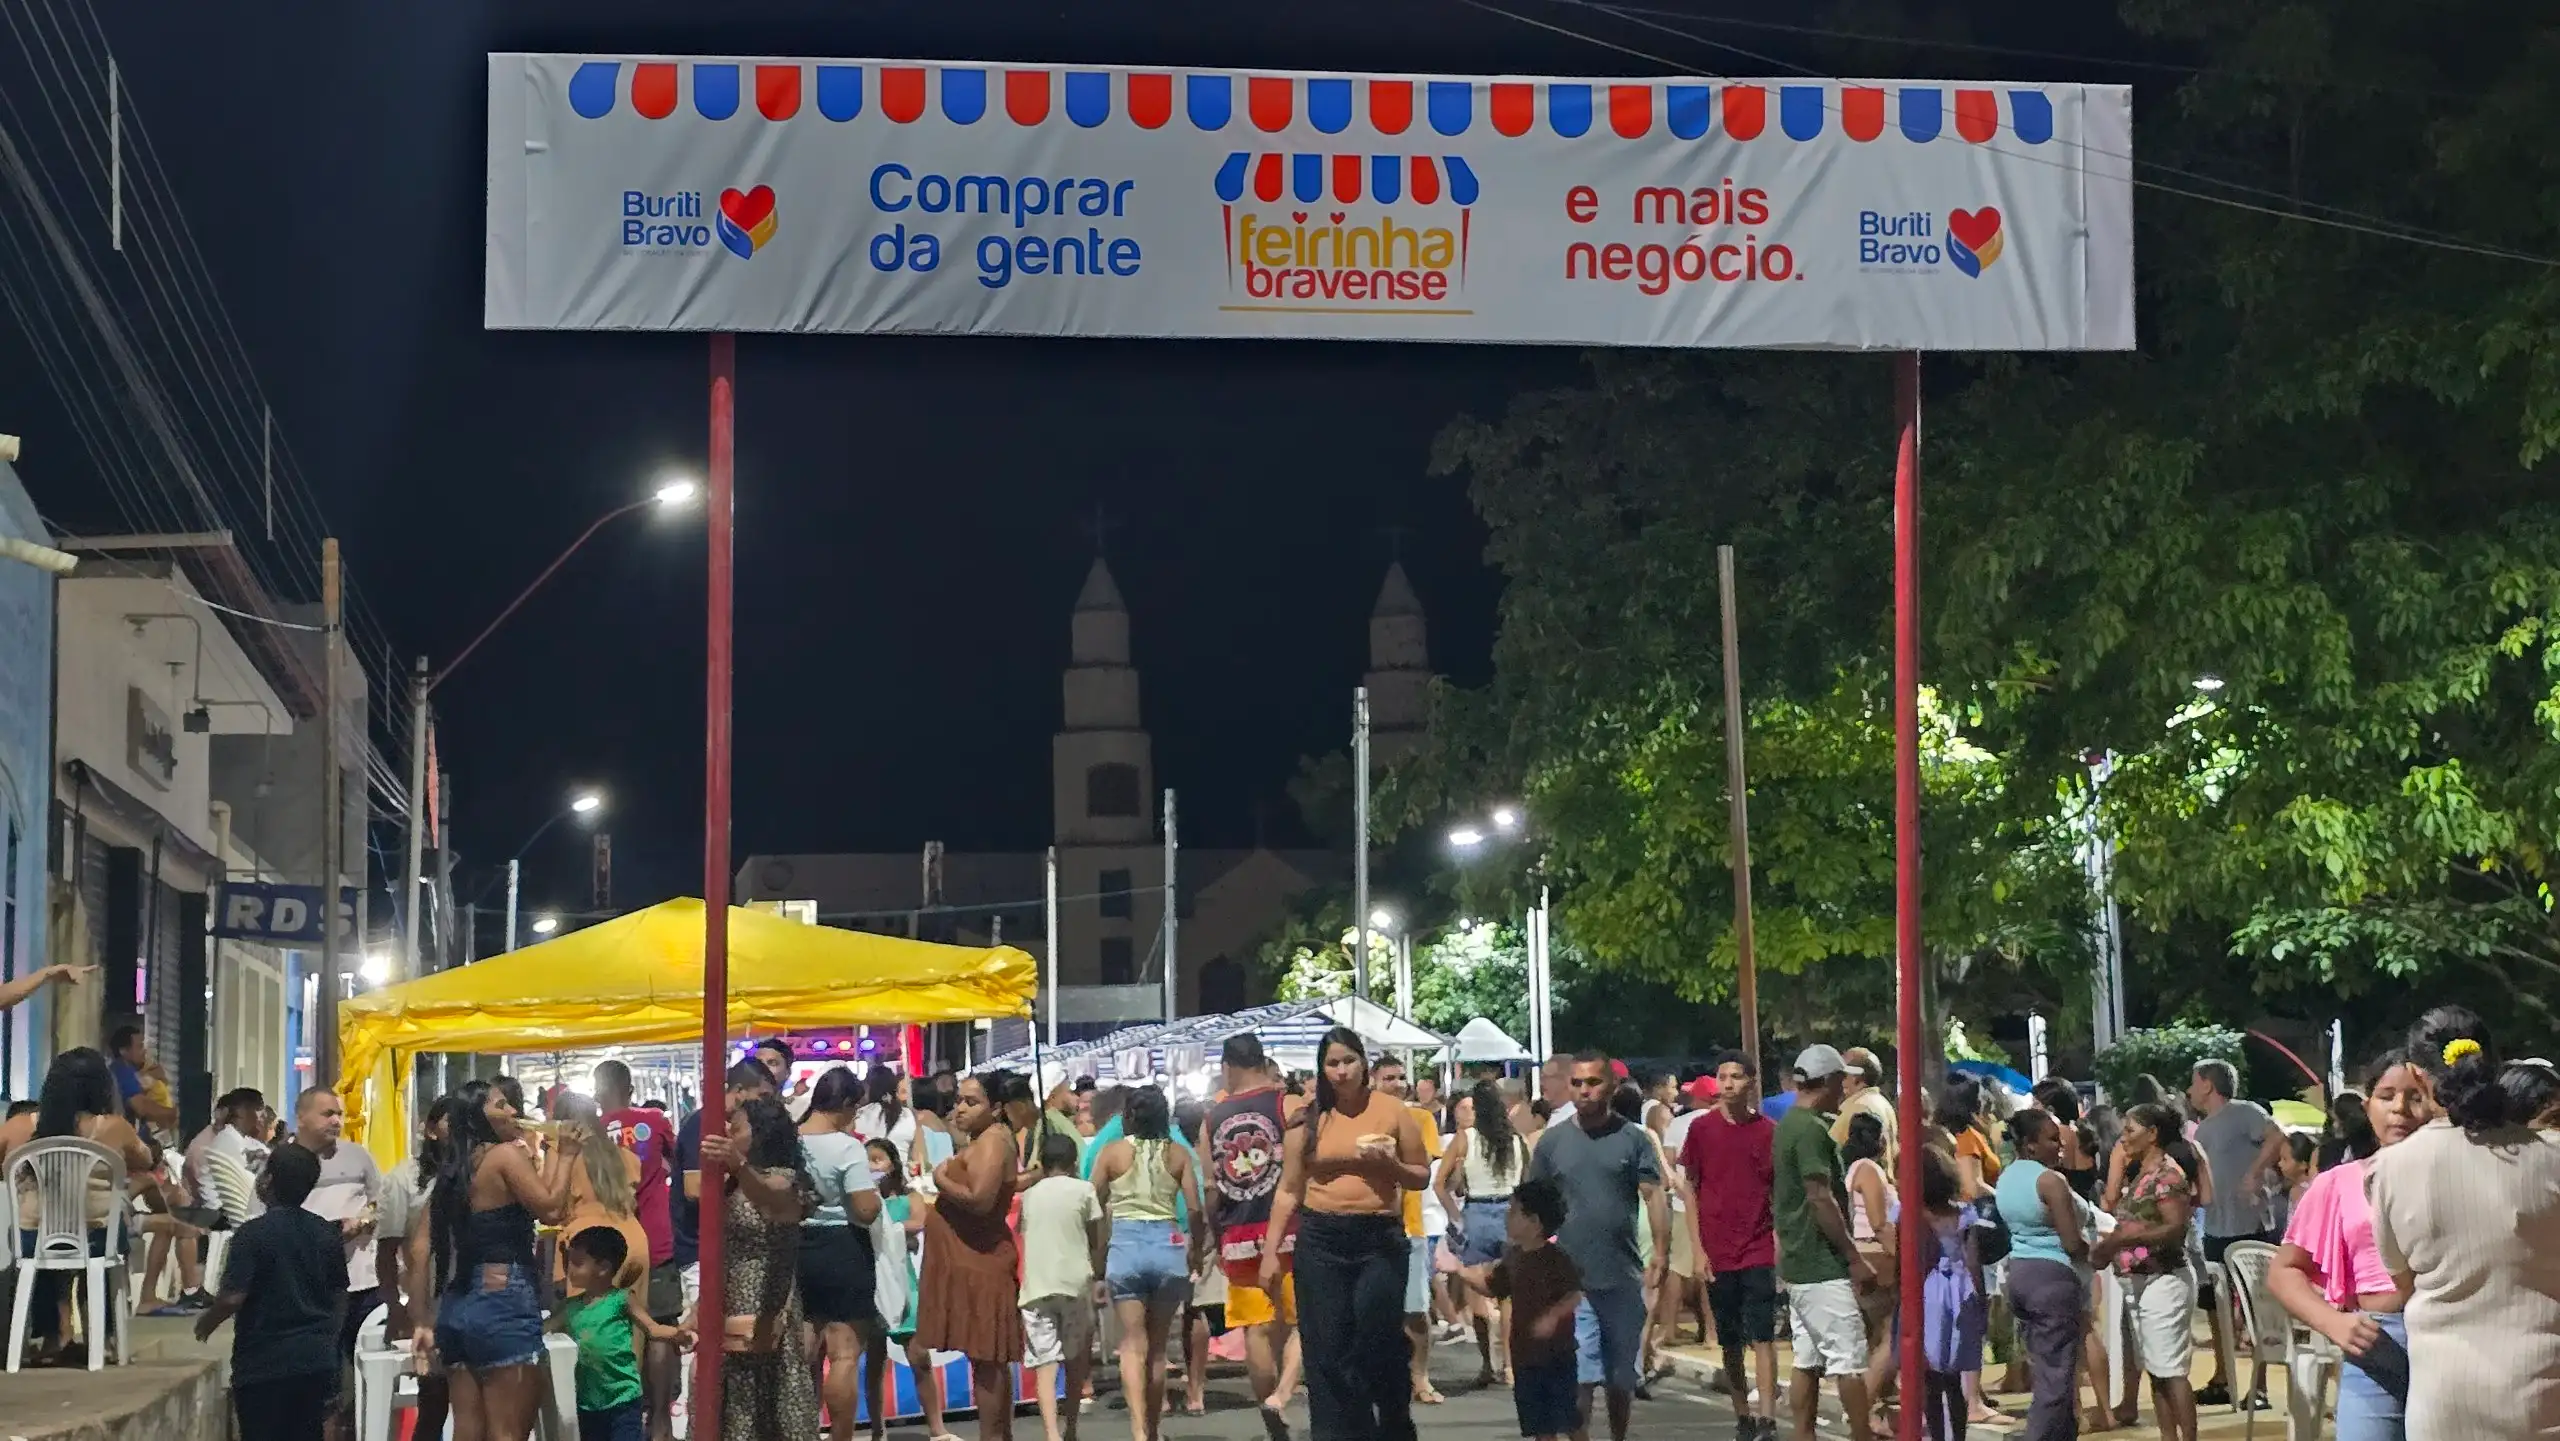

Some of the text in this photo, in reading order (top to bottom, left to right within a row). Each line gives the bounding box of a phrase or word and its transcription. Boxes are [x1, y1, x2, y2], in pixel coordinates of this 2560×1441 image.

[623, 190, 701, 217] Buriti
[869, 163, 1134, 229] Comprar
[1565, 177, 1769, 225] e mais
[623, 219, 711, 247] Bravo
[1240, 211, 1455, 269] feirinha
[1859, 211, 1932, 237] Buriti
[869, 223, 1141, 289] da gente
[1565, 233, 1805, 296] negócio.
[1859, 238, 1941, 264] Bravo
[1246, 259, 1448, 301] bravense
